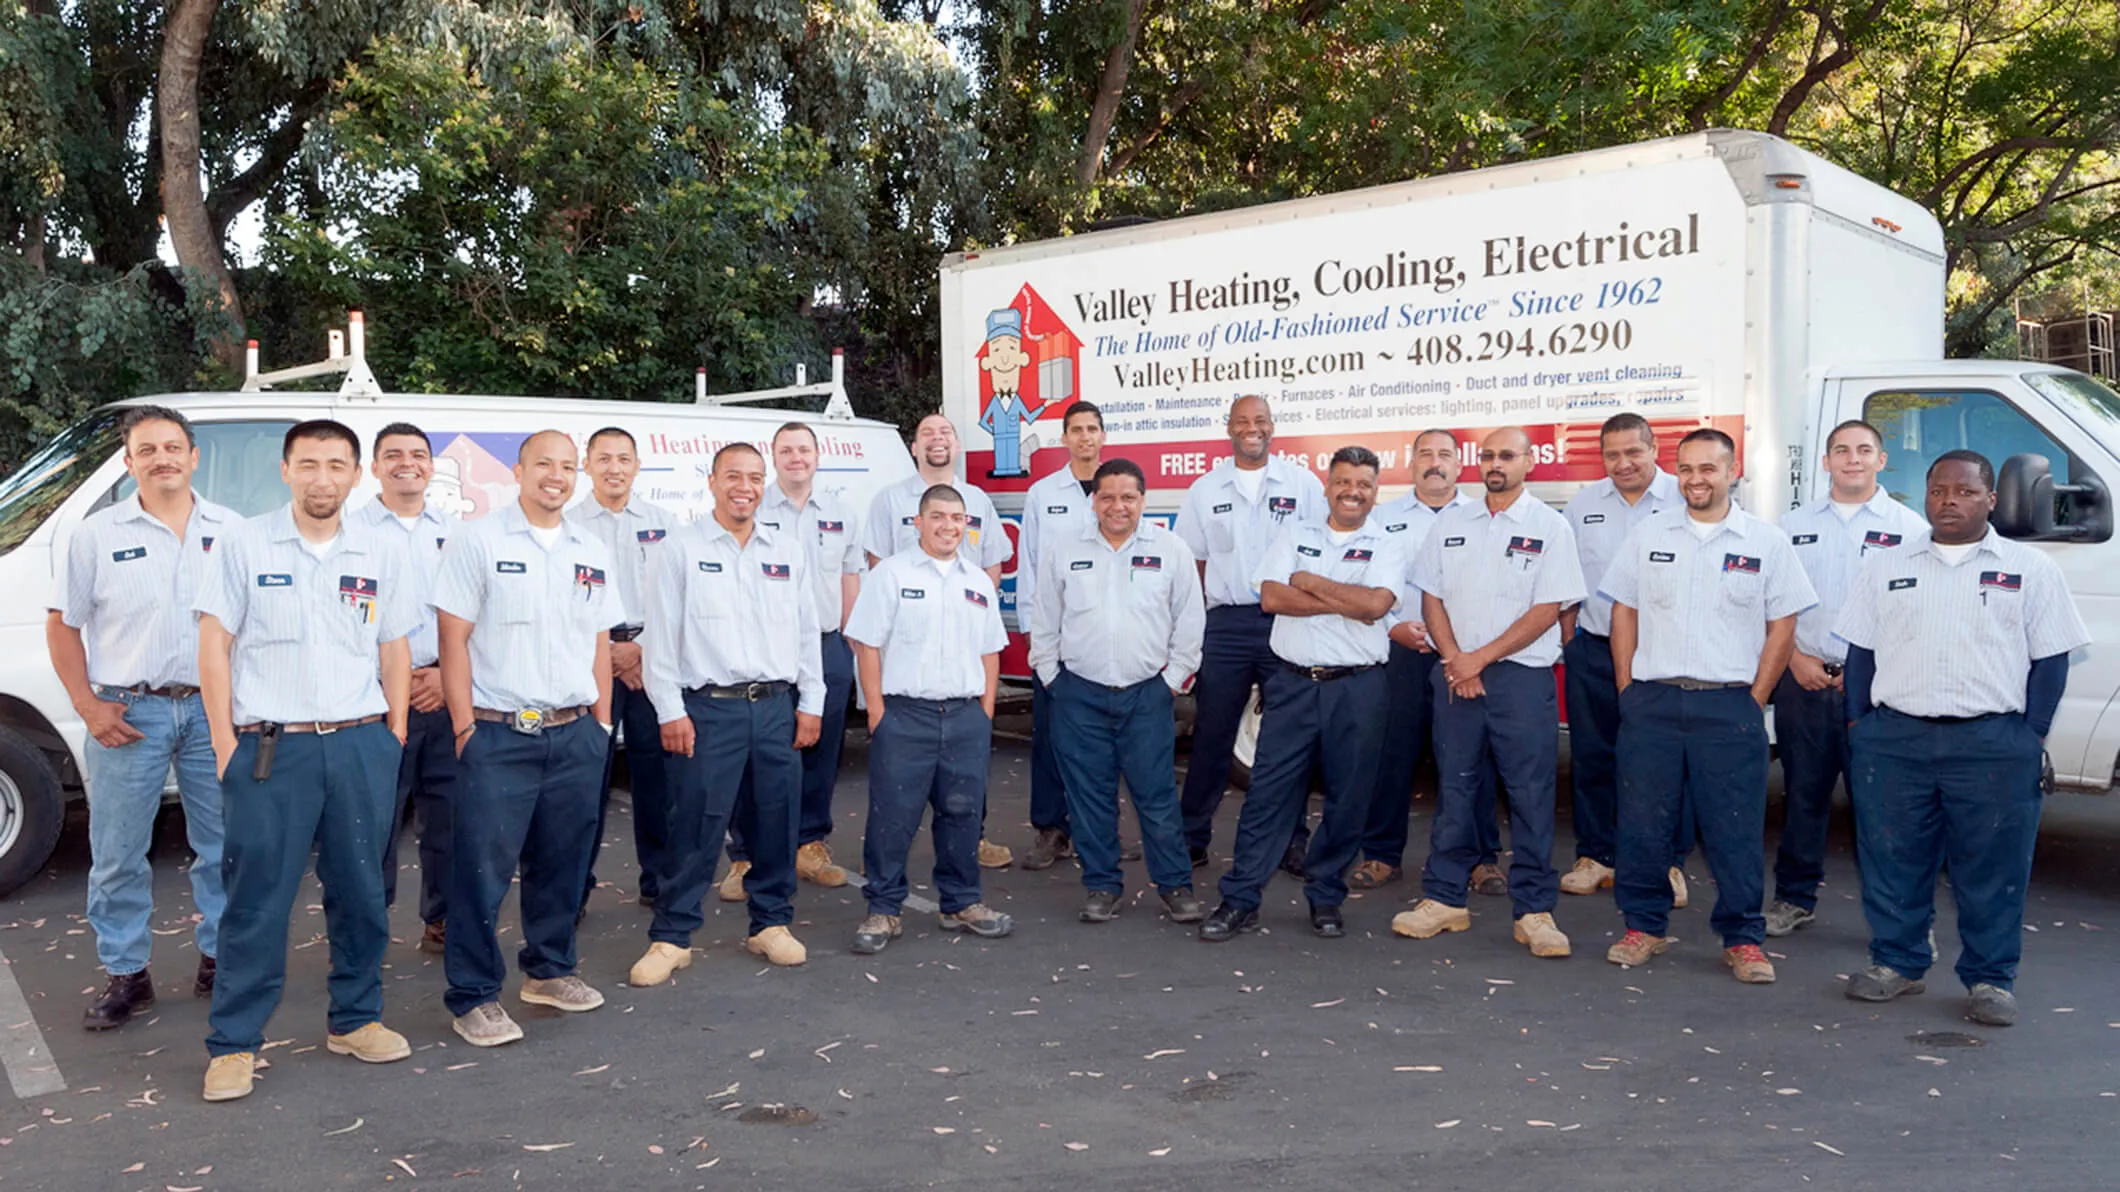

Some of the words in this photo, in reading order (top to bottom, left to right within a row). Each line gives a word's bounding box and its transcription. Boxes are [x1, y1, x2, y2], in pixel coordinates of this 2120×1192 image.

[1073, 288, 1156, 326] Valley
[1168, 271, 1301, 311] Heating,
[1313, 250, 1467, 293] Cooling,
[1482, 213, 1699, 278] Electrical
[1095, 336, 1129, 357] The
[1135, 330, 1190, 354] Home
[1197, 325, 1219, 352] of
[1225, 306, 1390, 345] Old-Fashioned
[1508, 286, 1584, 319] Since
[1597, 276, 1663, 309] 1962
[1114, 350, 1364, 391] ValleyHeating.com
[1407, 318, 1633, 366] 408.294.6290
[1099, 400, 1145, 414] stallation
[1155, 396, 1222, 410] Maintenance
[1282, 389, 1335, 402] Furnaces
[1348, 383, 1365, 398] Air
[1370, 379, 1451, 396] Conditioning
[1466, 376, 1497, 390] Duct
[1502, 373, 1528, 387] and
[1533, 370, 1571, 388] dryer
[1577, 367, 1609, 383] vent
[1615, 363, 1683, 380] cleaning
[1104, 419, 1133, 433] wn-in
[1135, 418, 1159, 431] attic
[1161, 414, 1212, 429] insulation
[1315, 403, 1373, 421] Electrical
[1377, 399, 1436, 419] services:
[1502, 394, 1541, 413] panel
[820, 436, 864, 460] ling
[1160, 451, 1207, 476] FREE
